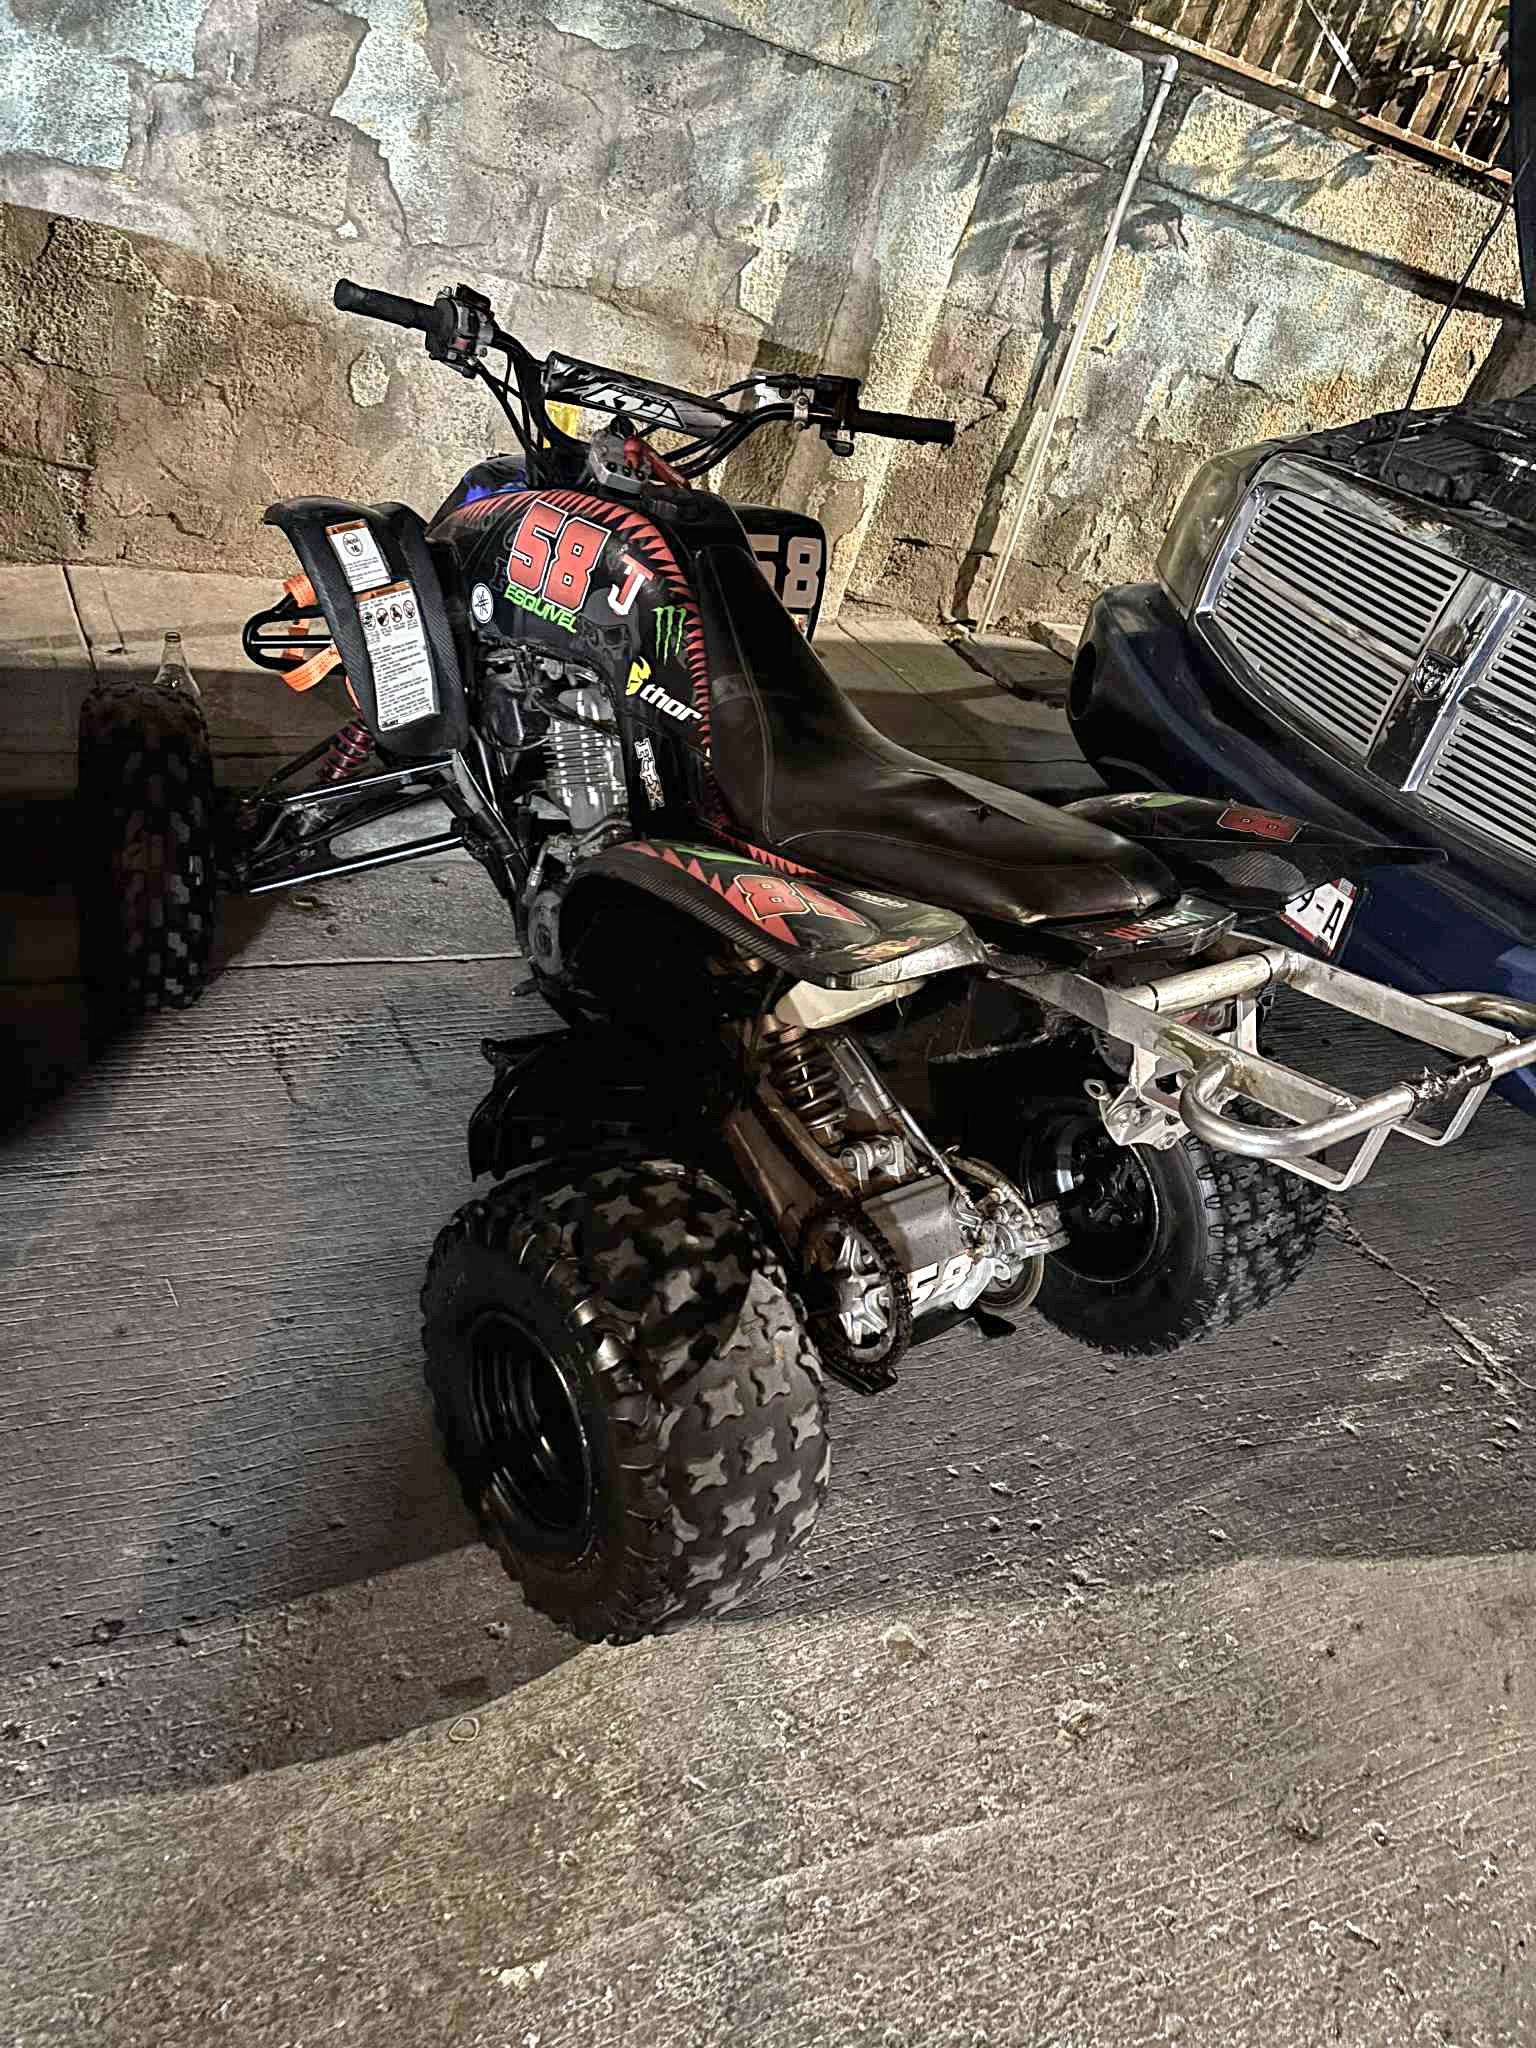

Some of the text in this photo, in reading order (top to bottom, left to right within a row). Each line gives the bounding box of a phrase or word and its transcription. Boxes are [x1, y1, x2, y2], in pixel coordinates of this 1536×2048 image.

[507, 499, 612, 614] 58
[608, 553, 654, 616] J
[503, 584, 577, 634] ESQUIVEL
[639, 683, 703, 721] thor
